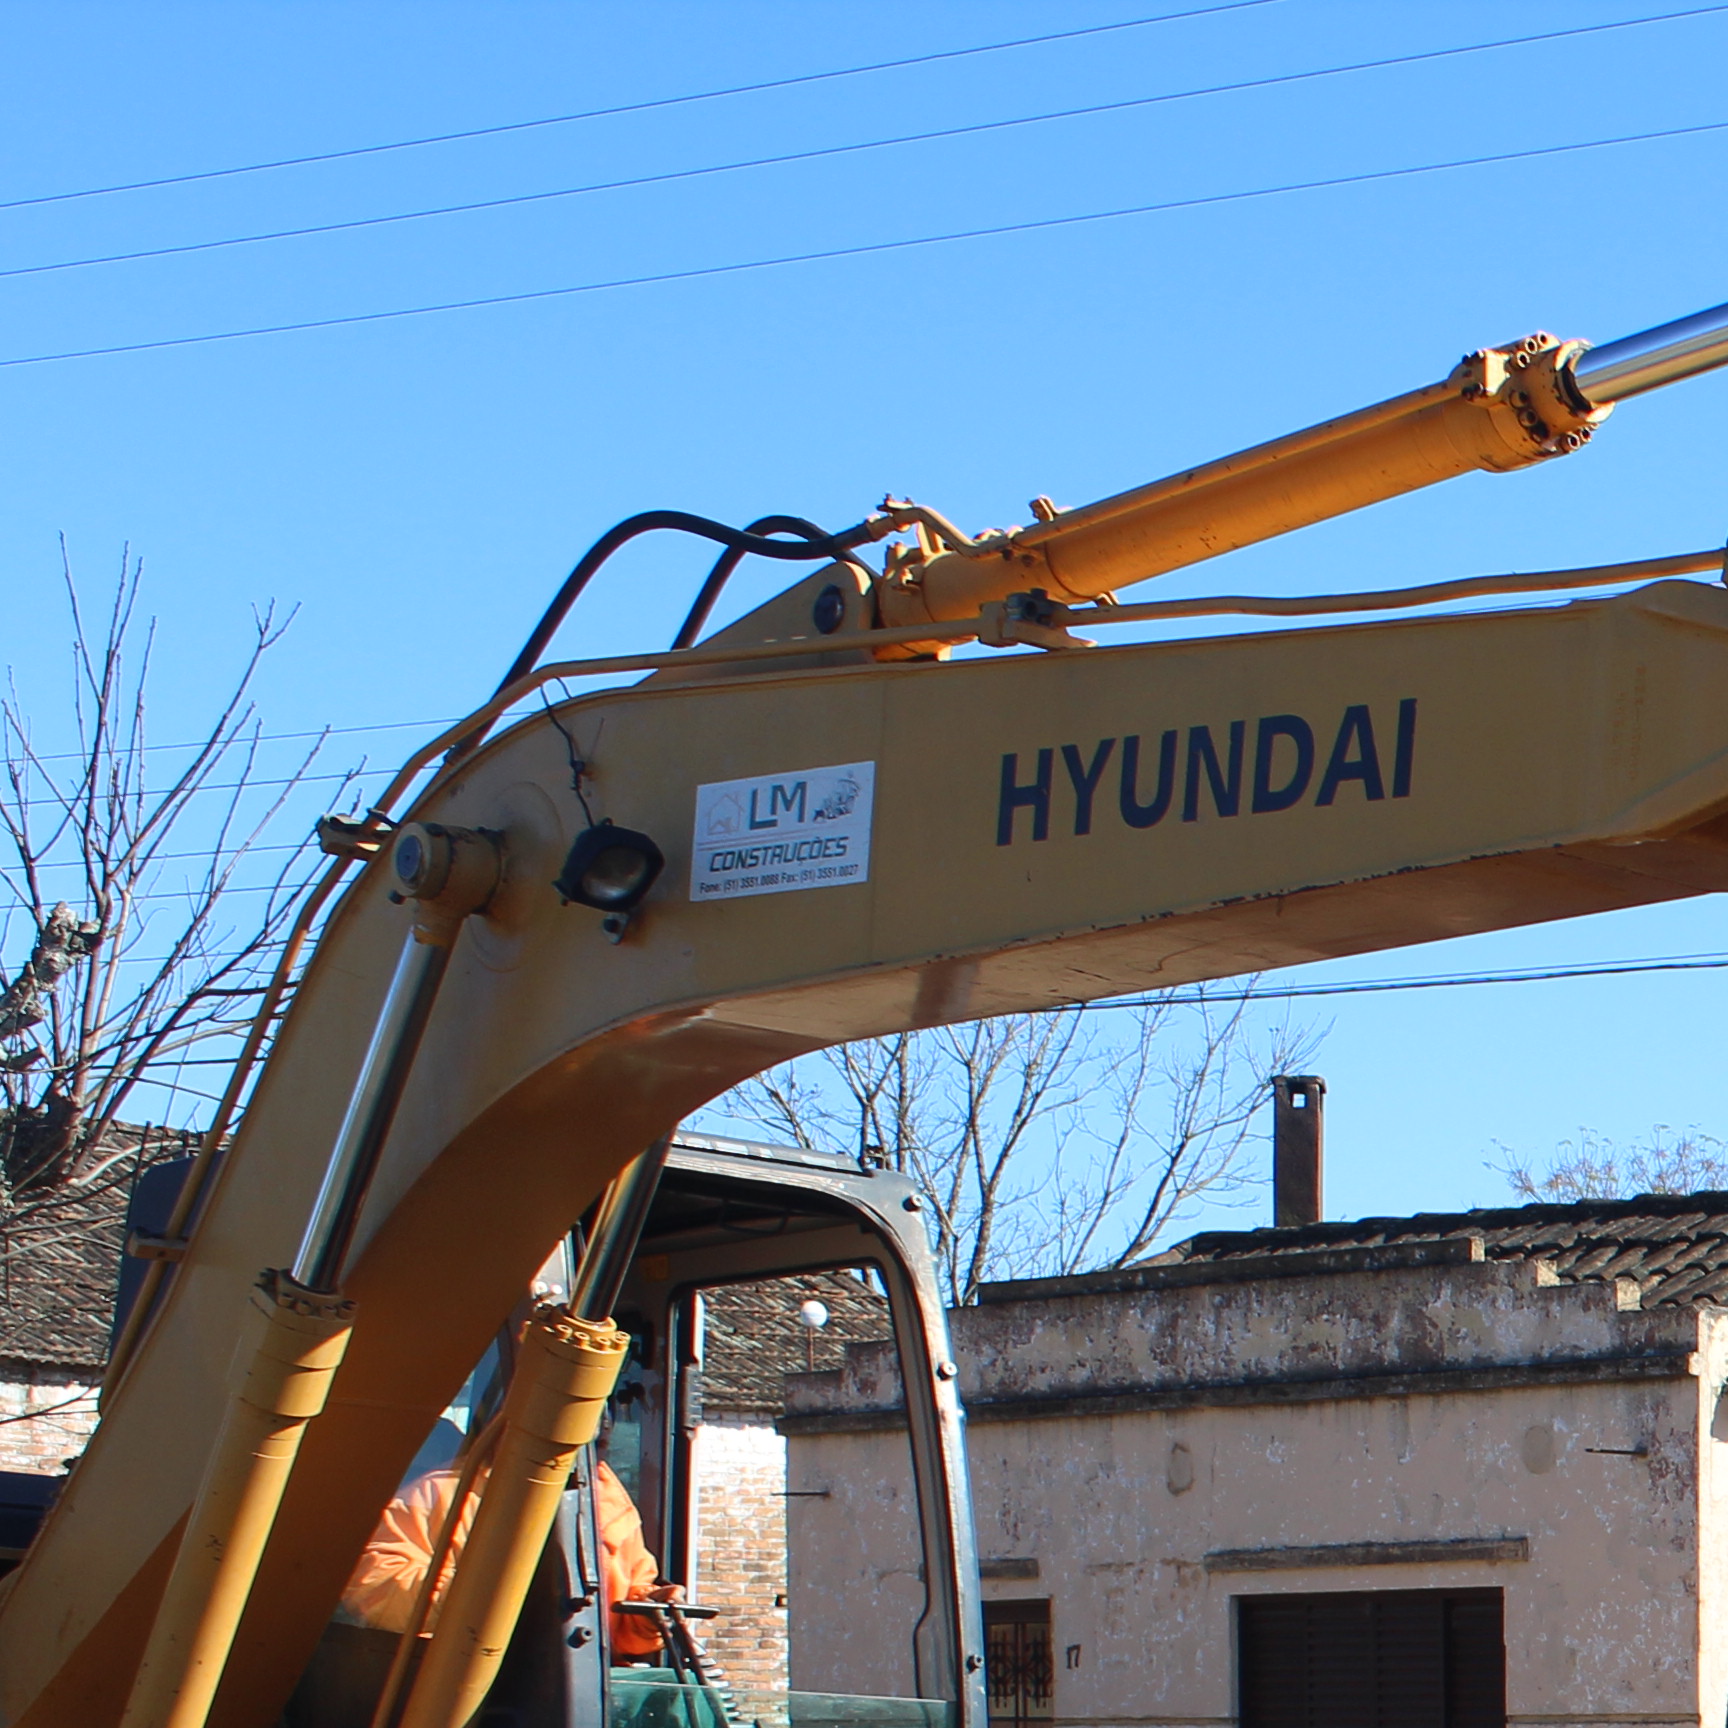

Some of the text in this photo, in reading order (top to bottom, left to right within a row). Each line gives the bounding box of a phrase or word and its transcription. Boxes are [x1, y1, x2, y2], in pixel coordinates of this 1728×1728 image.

[996, 698, 1417, 846] HYUNDAI
[749, 781, 808, 830] LM
[700, 881, 721, 894] Fone:
[781, 872, 798, 884] Fax:
